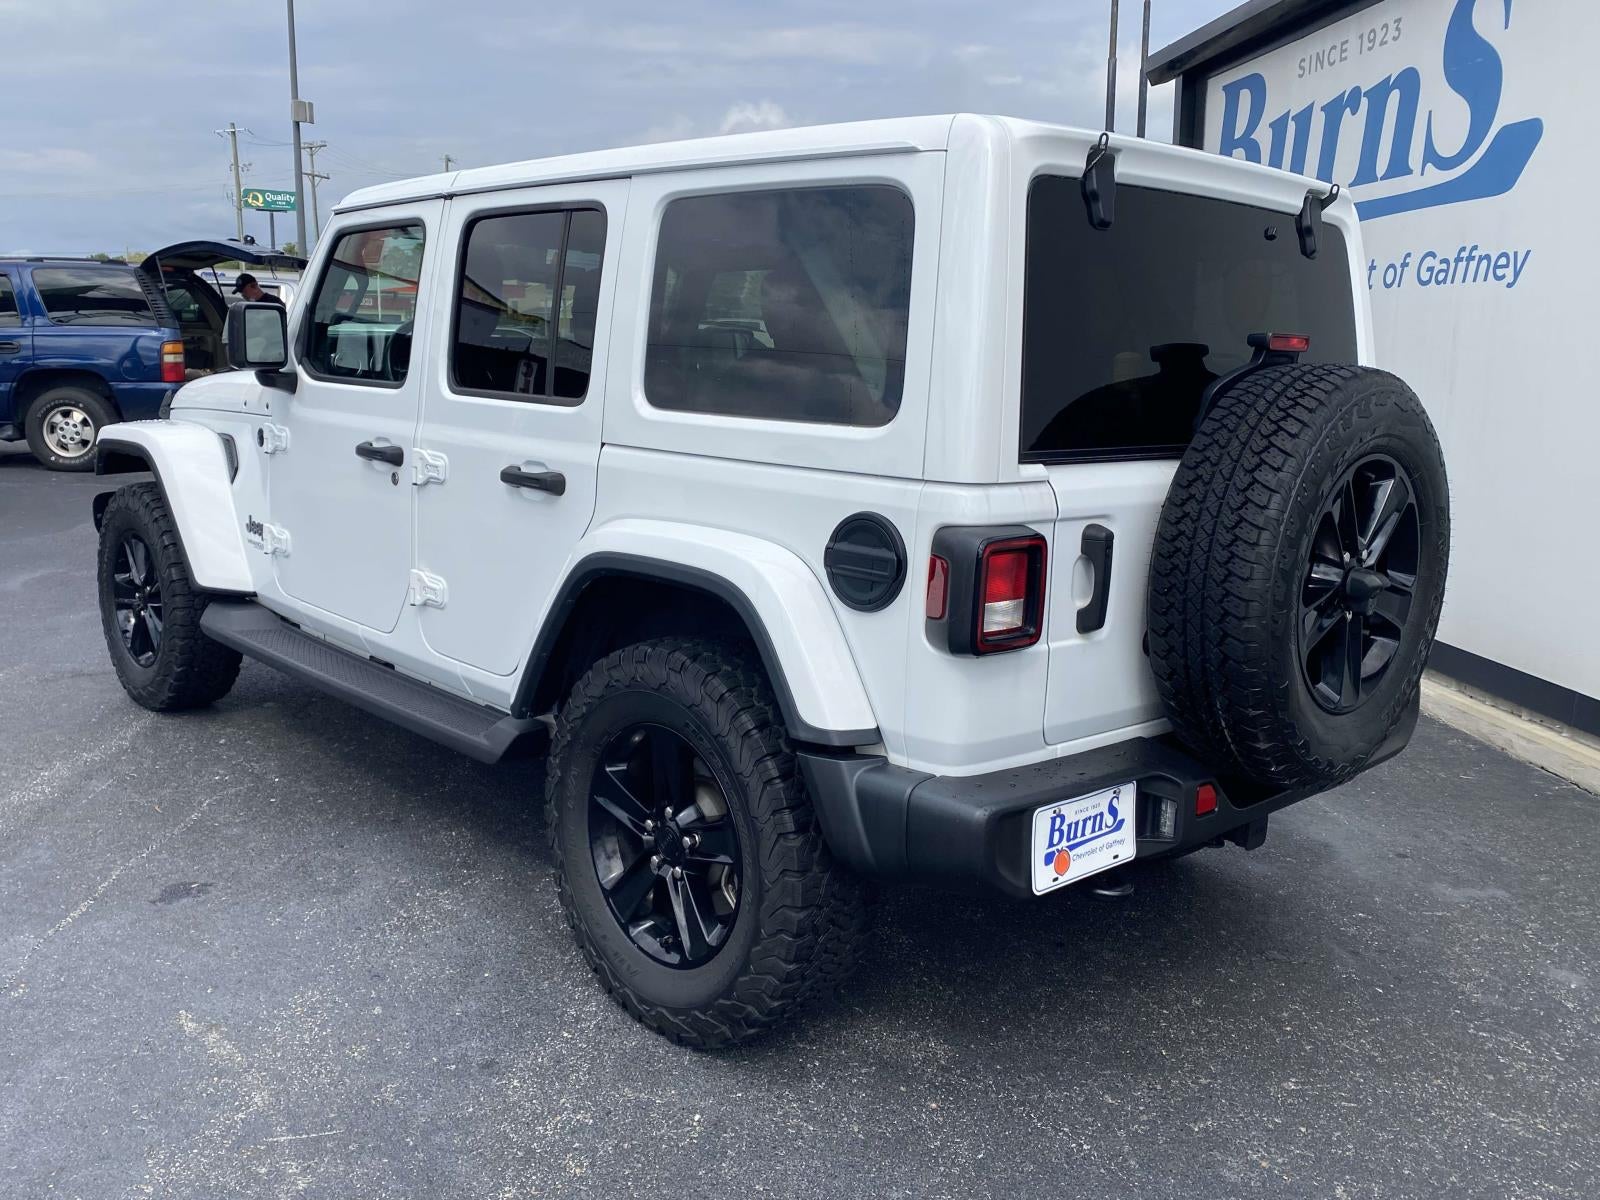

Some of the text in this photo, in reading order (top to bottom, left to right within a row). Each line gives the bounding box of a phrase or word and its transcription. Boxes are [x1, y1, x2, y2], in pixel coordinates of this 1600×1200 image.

[1298, 17, 1402, 78] SINCE 1923
[265, 192, 295, 203] Quality
[1382, 252, 1412, 289] of
[1416, 244, 1532, 289] Gaffney
